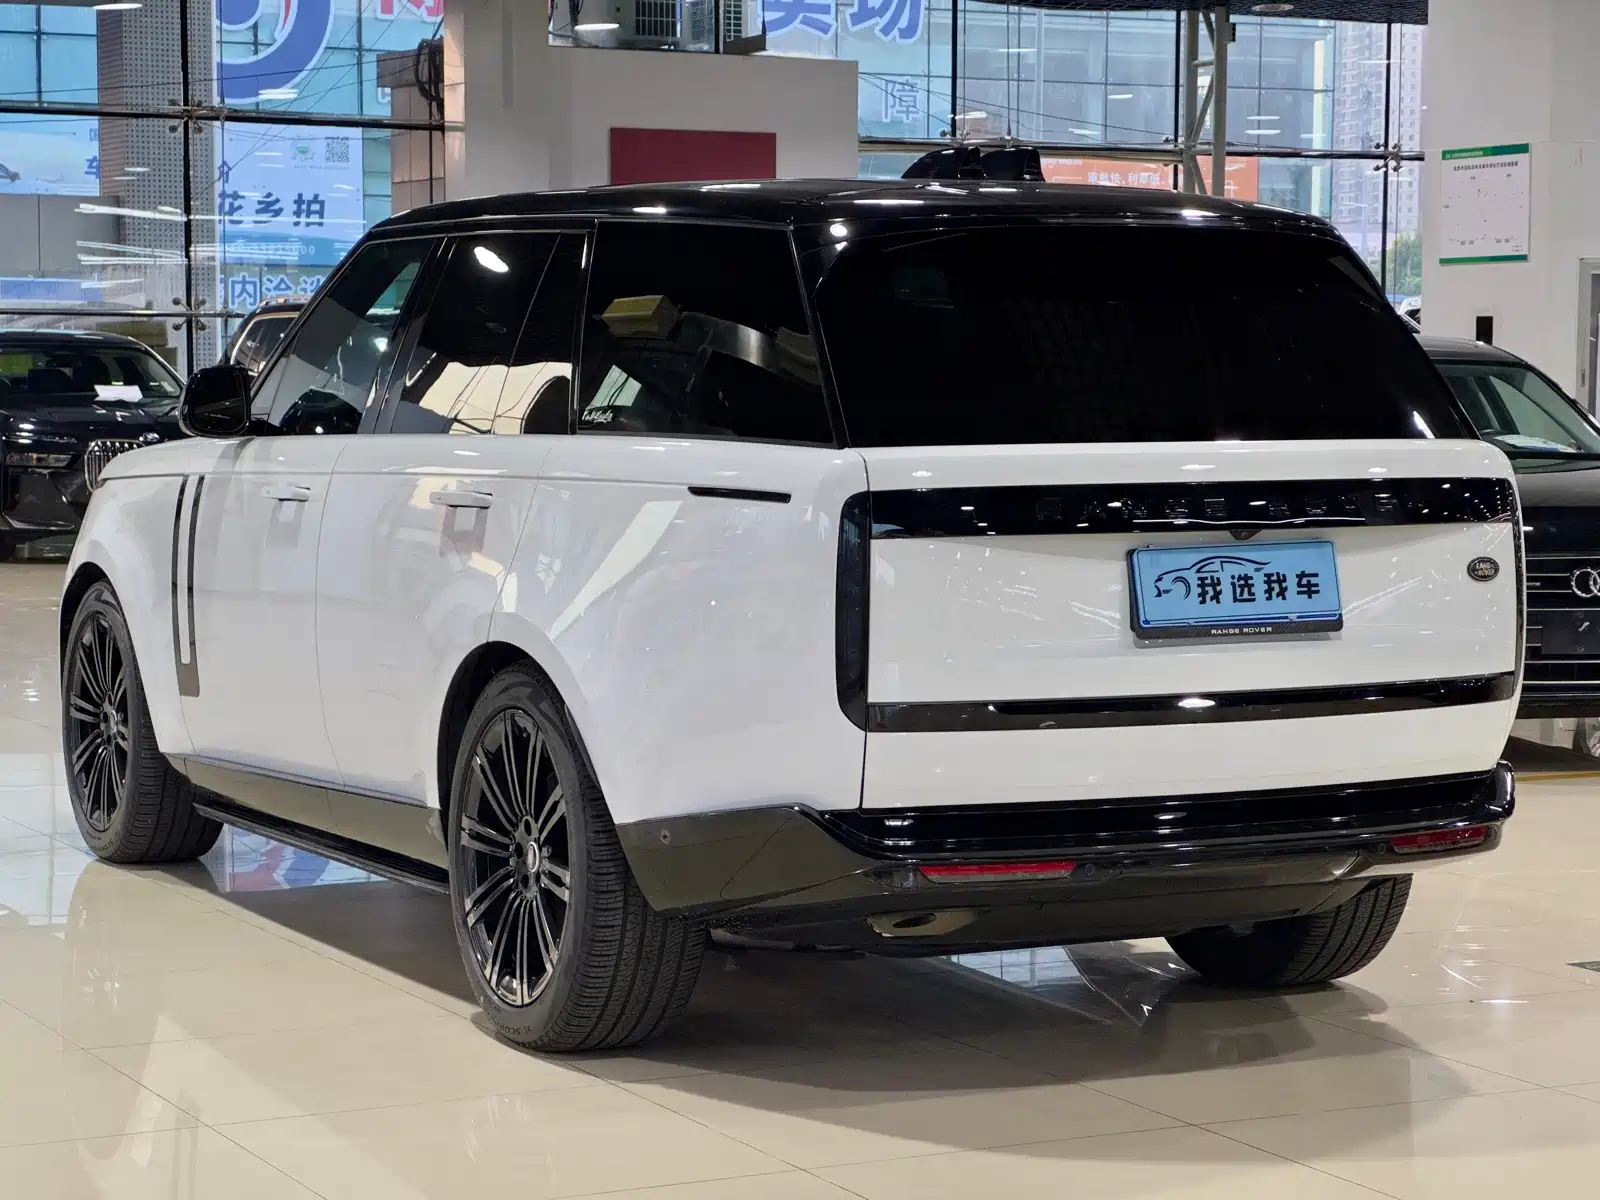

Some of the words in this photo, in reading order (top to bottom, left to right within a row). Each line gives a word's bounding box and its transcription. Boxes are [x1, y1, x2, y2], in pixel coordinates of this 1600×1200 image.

[882, 77, 921, 122] 障
[218, 190, 325, 227] 花乡拍
[1197, 570, 1320, 605] 我选我车
